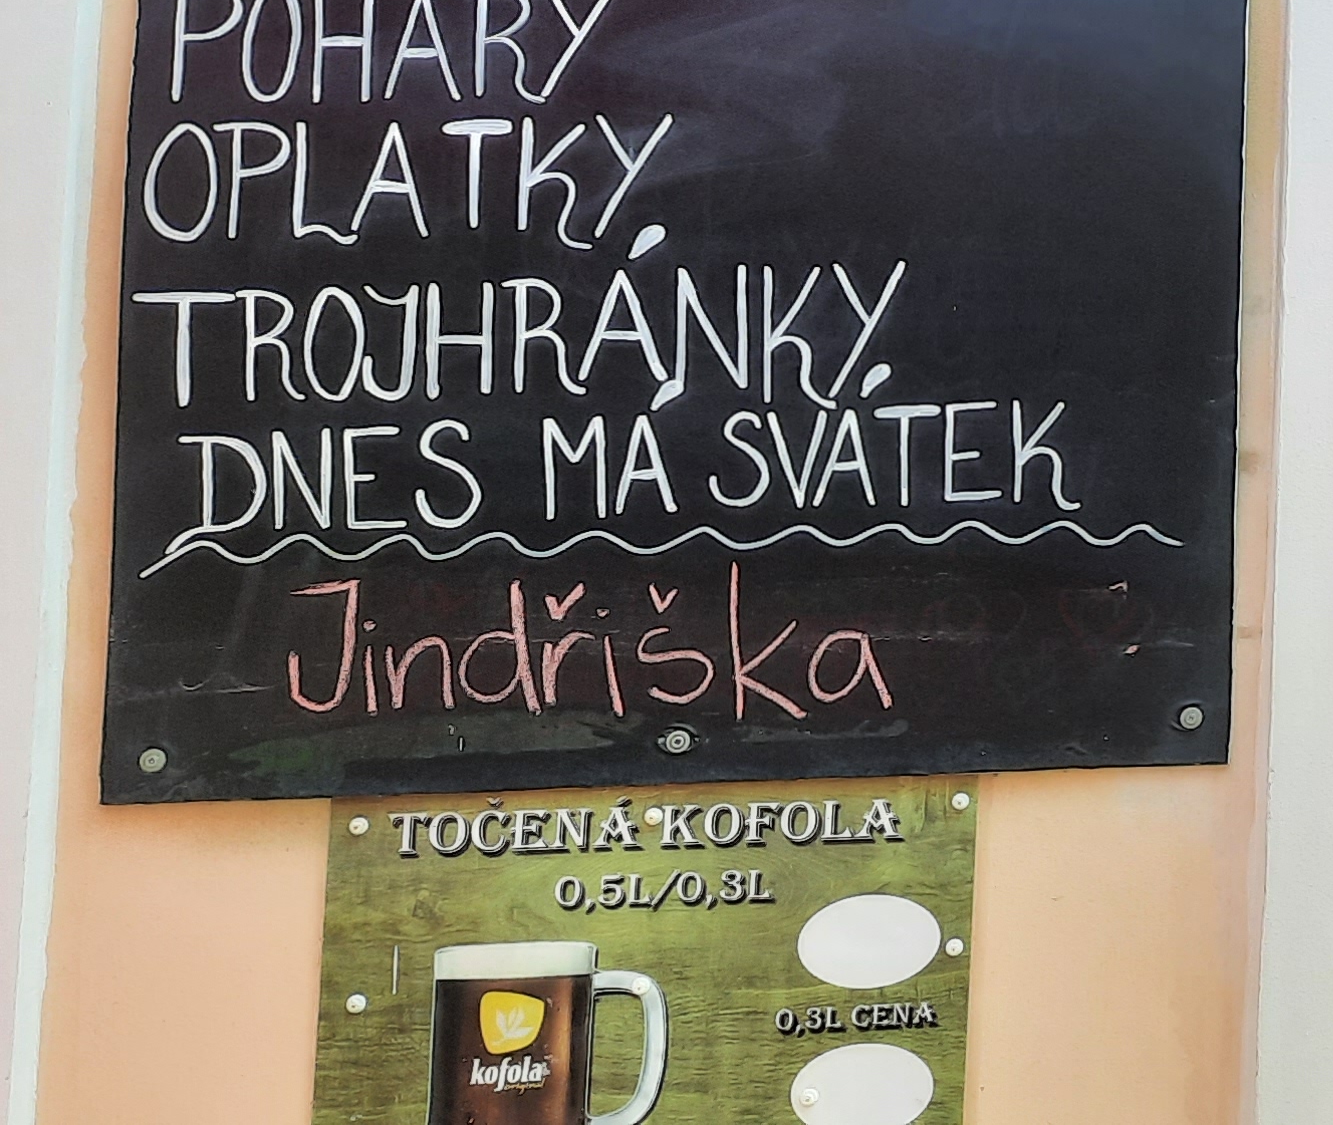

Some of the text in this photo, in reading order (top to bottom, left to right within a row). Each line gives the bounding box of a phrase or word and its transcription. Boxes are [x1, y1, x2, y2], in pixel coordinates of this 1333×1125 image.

[142, 113, 673, 249] OPLATKY
[130, 223, 908, 409] TROJHRÁNKY
[164, 361, 1081, 554] DNES MÁ SVÁTEK
[286, 561, 895, 721] Jindřiška
[390, 795, 903, 858] TOČENÁ KOFOLA
[554, 868, 774, 916] 0,5L/0,3L
[775, 1002, 939, 1038] 0,3L CENA
[470, 1055, 548, 1093] kofola
